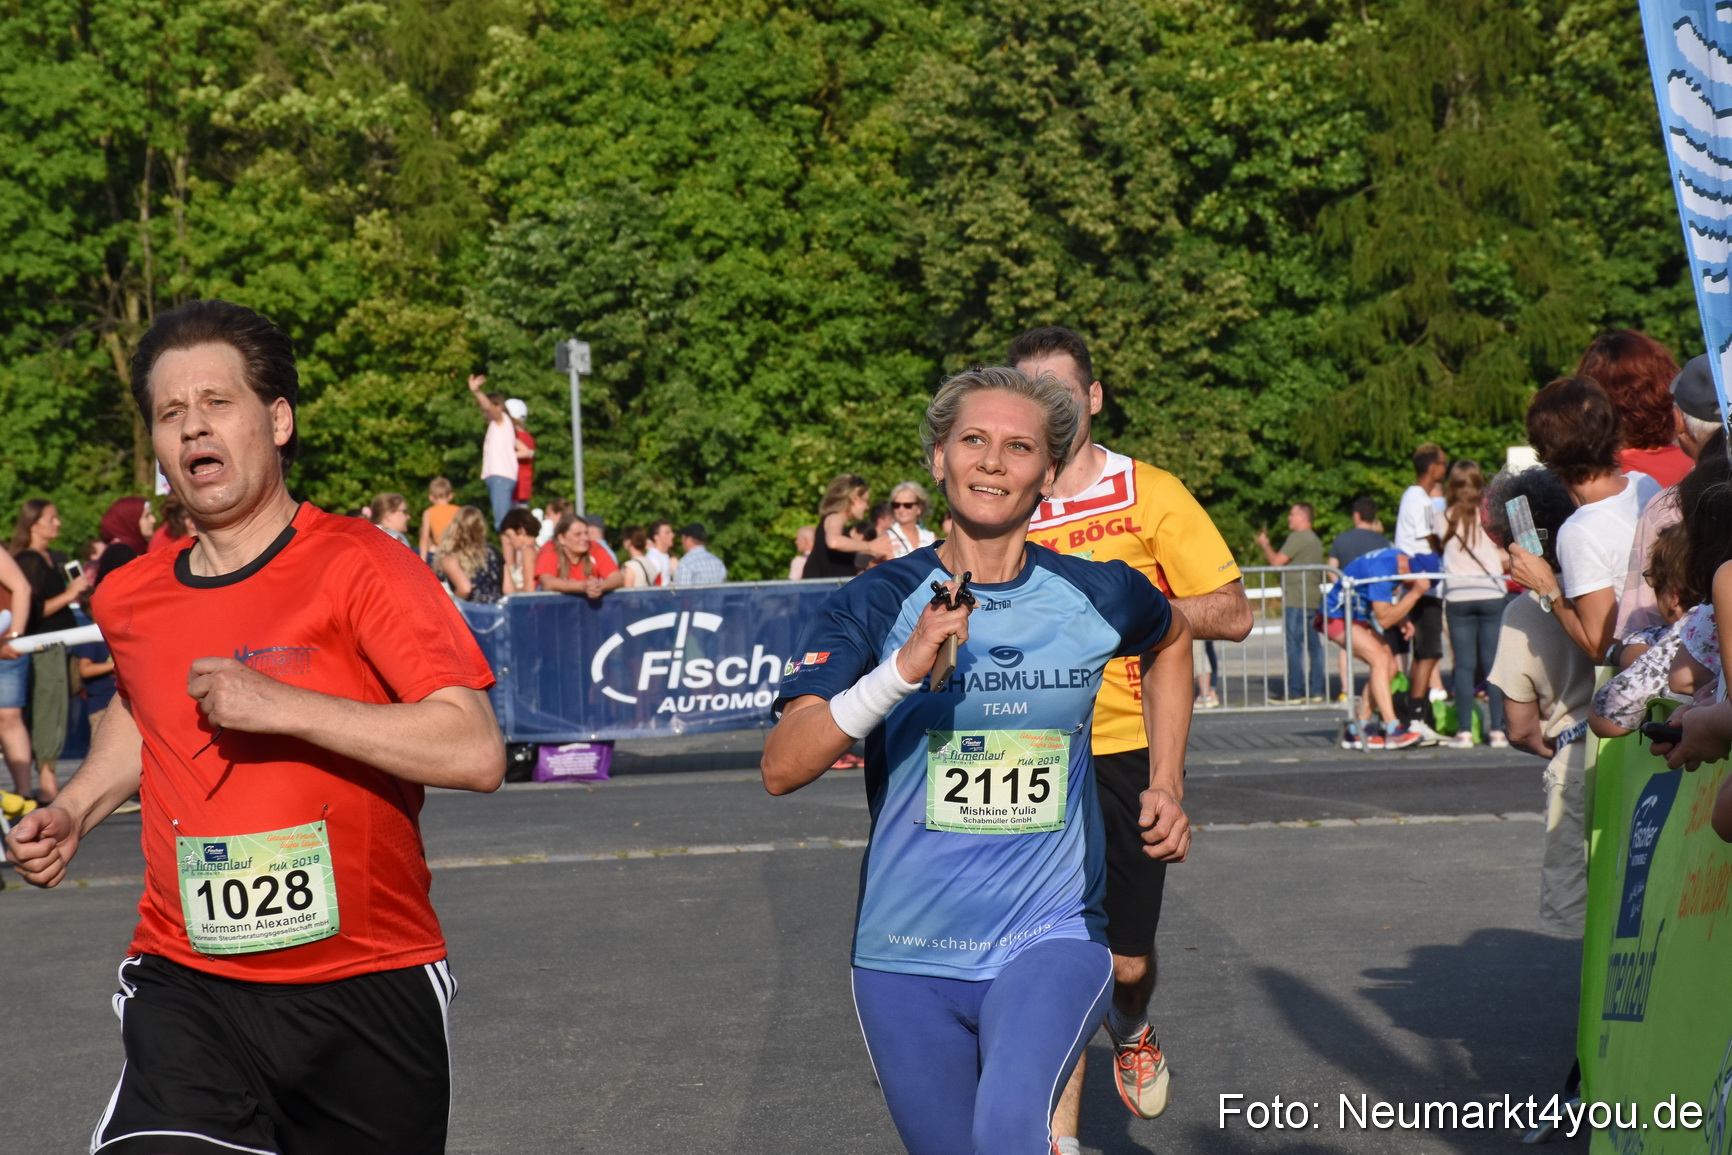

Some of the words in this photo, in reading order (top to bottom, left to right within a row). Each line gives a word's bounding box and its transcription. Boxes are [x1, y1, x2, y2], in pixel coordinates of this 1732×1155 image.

[1069, 516, 1142, 549] BÖGL
[637, 644, 782, 691] Fisch
[920, 668, 1092, 694] SHABMÜLLER
[983, 702, 1028, 716] TEAM
[950, 750, 1006, 761] firmenlauf
[1037, 756, 1060, 766] 2019
[943, 767, 1050, 805] 2115
[959, 806, 1008, 816] Mishkine
[1011, 806, 1037, 815] Yulia
[963, 817, 1008, 825] Schabmüller
[196, 857, 253, 872] firmenlauf
[292, 854, 320, 869] 2019
[197, 869, 314, 921] 1028
[194, 933, 218, 942] Hörmann
[218, 923, 313, 942] Steuerberatungsgesellschaft
[314, 919, 330, 927] mbH
[201, 921, 252, 934] Hörmann
[255, 911, 317, 931] Alexander
[888, 923, 1052, 952] www.schabmeler.de
